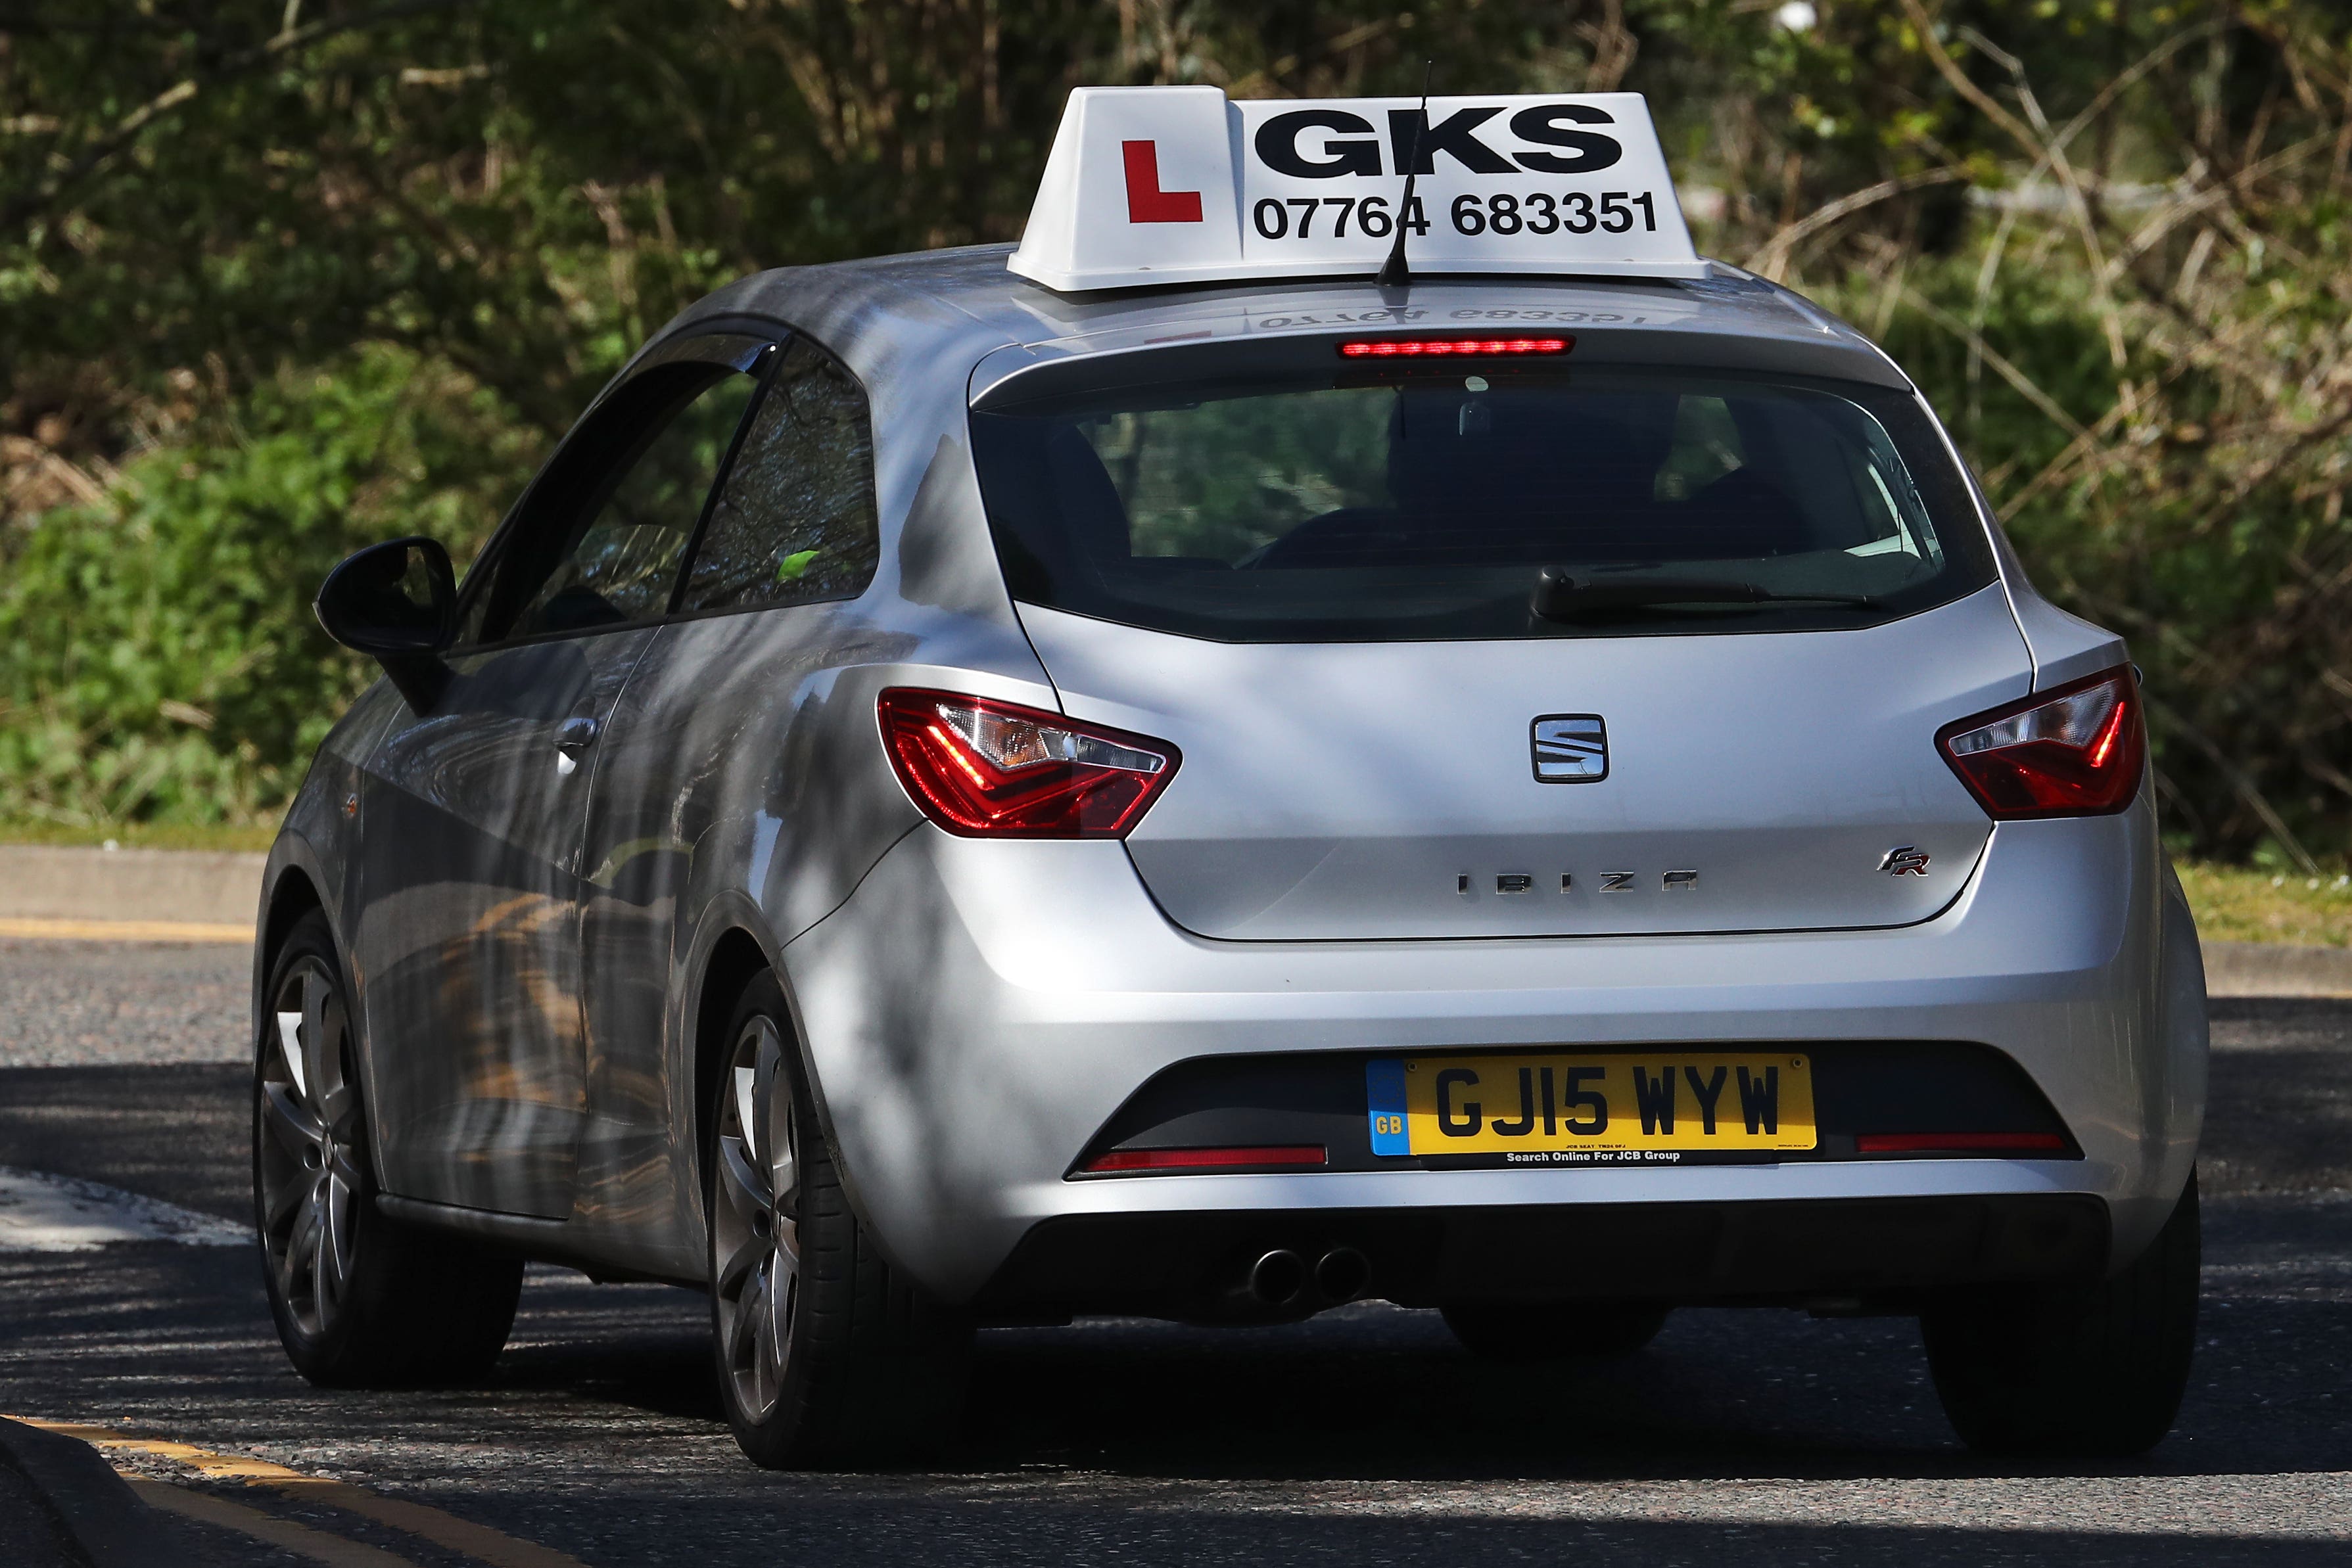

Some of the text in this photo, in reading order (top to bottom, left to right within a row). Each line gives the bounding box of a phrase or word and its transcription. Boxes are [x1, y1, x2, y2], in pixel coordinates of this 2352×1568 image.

[1254, 104, 1622, 179] GKS
[1121, 139, 1204, 223] L
[1253, 191, 1657, 239] 07764 683351
[1457, 869, 1697, 895] IBIZA
[1375, 1115, 1403, 1135] GB
[1436, 1065, 1779, 1138] GJ15 WYW
[1506, 1151, 1681, 1163] Search Online For JCB Group
